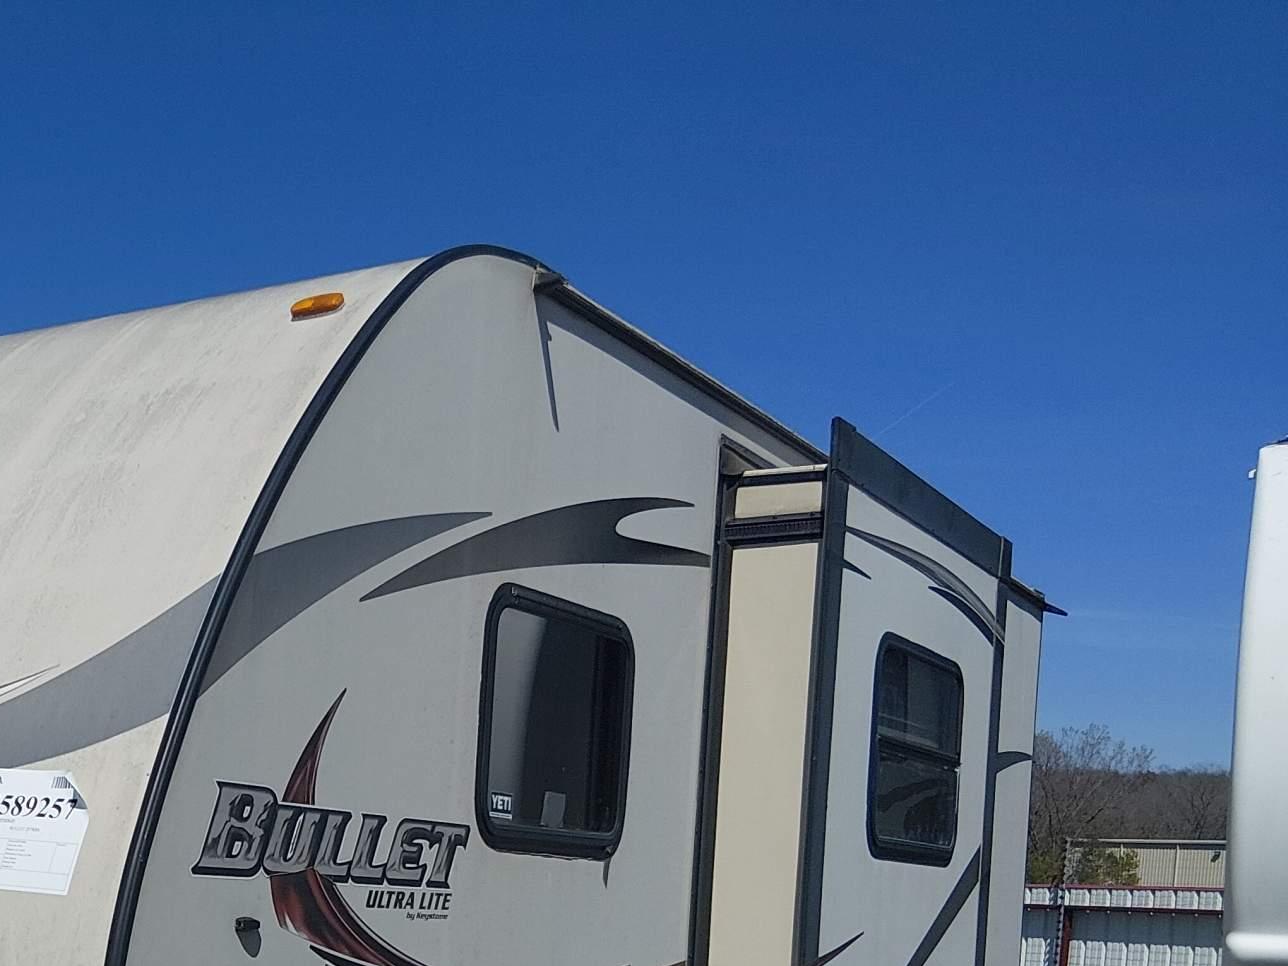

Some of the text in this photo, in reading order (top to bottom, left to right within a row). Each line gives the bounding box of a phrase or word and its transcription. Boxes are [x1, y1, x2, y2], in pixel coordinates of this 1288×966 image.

[491, 794, 512, 811] YETI
[191, 780, 470, 888] BULLET
[365, 889, 452, 911] ULTRA LITE
[406, 912, 415, 920] by
